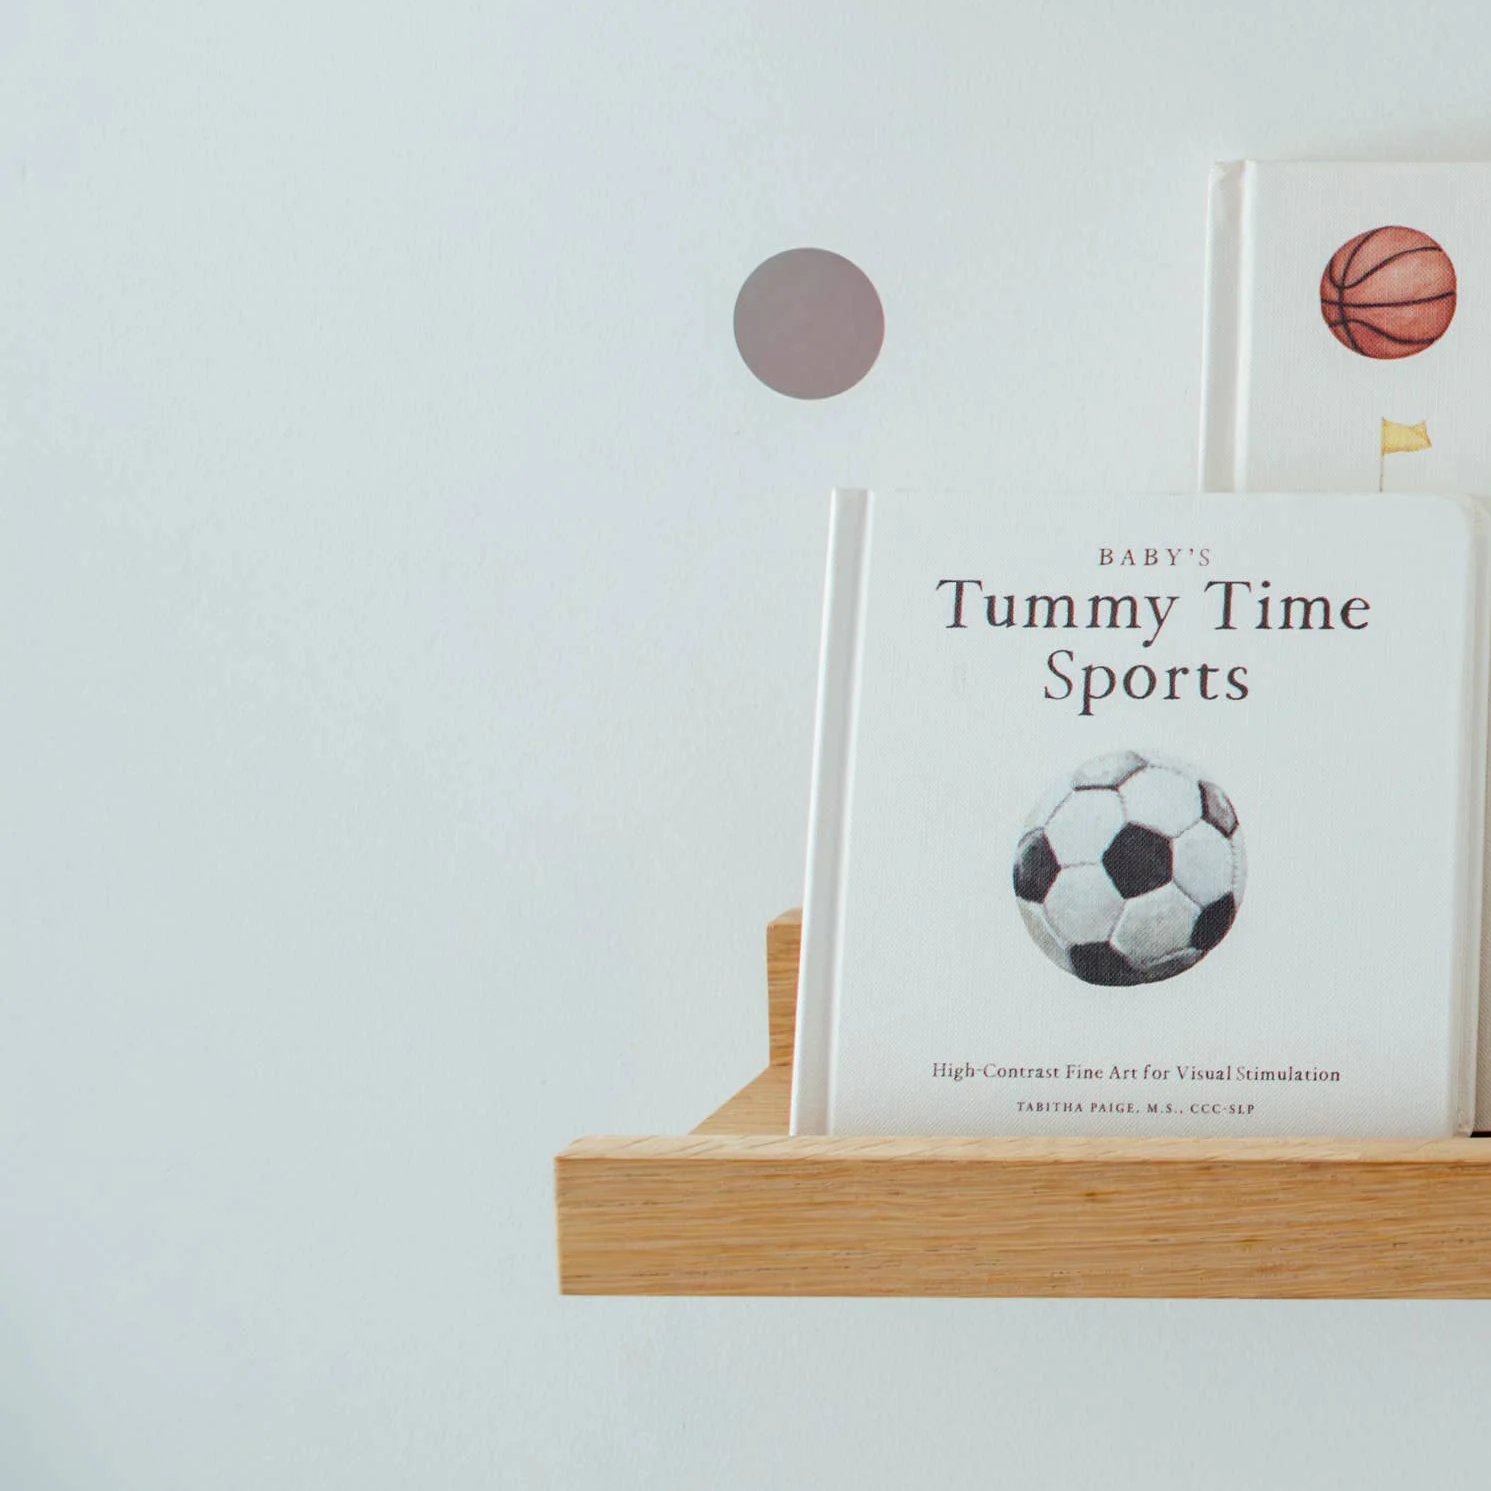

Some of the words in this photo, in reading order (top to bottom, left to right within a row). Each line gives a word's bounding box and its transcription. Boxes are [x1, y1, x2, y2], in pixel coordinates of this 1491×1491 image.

[1098, 548, 1211, 567] BABY'S
[935, 578, 1180, 648] Tummy
[1204, 580, 1371, 631] Time
[1043, 649, 1250, 717] Sports
[932, 1062, 1060, 1082] High-Contrast
[1066, 1064, 1104, 1080] Fine
[1109, 1064, 1138, 1080] Art
[1143, 1064, 1170, 1080] for
[1177, 1065, 1231, 1081] Visual
[1236, 1065, 1341, 1082] Stimulation
[1016, 1101, 1084, 1112] TABITHA
[1090, 1102, 1140, 1114] PAIGE,
[1147, 1103, 1184, 1114] M.S.,
[1189, 1103, 1255, 1115] CCC-SLP
